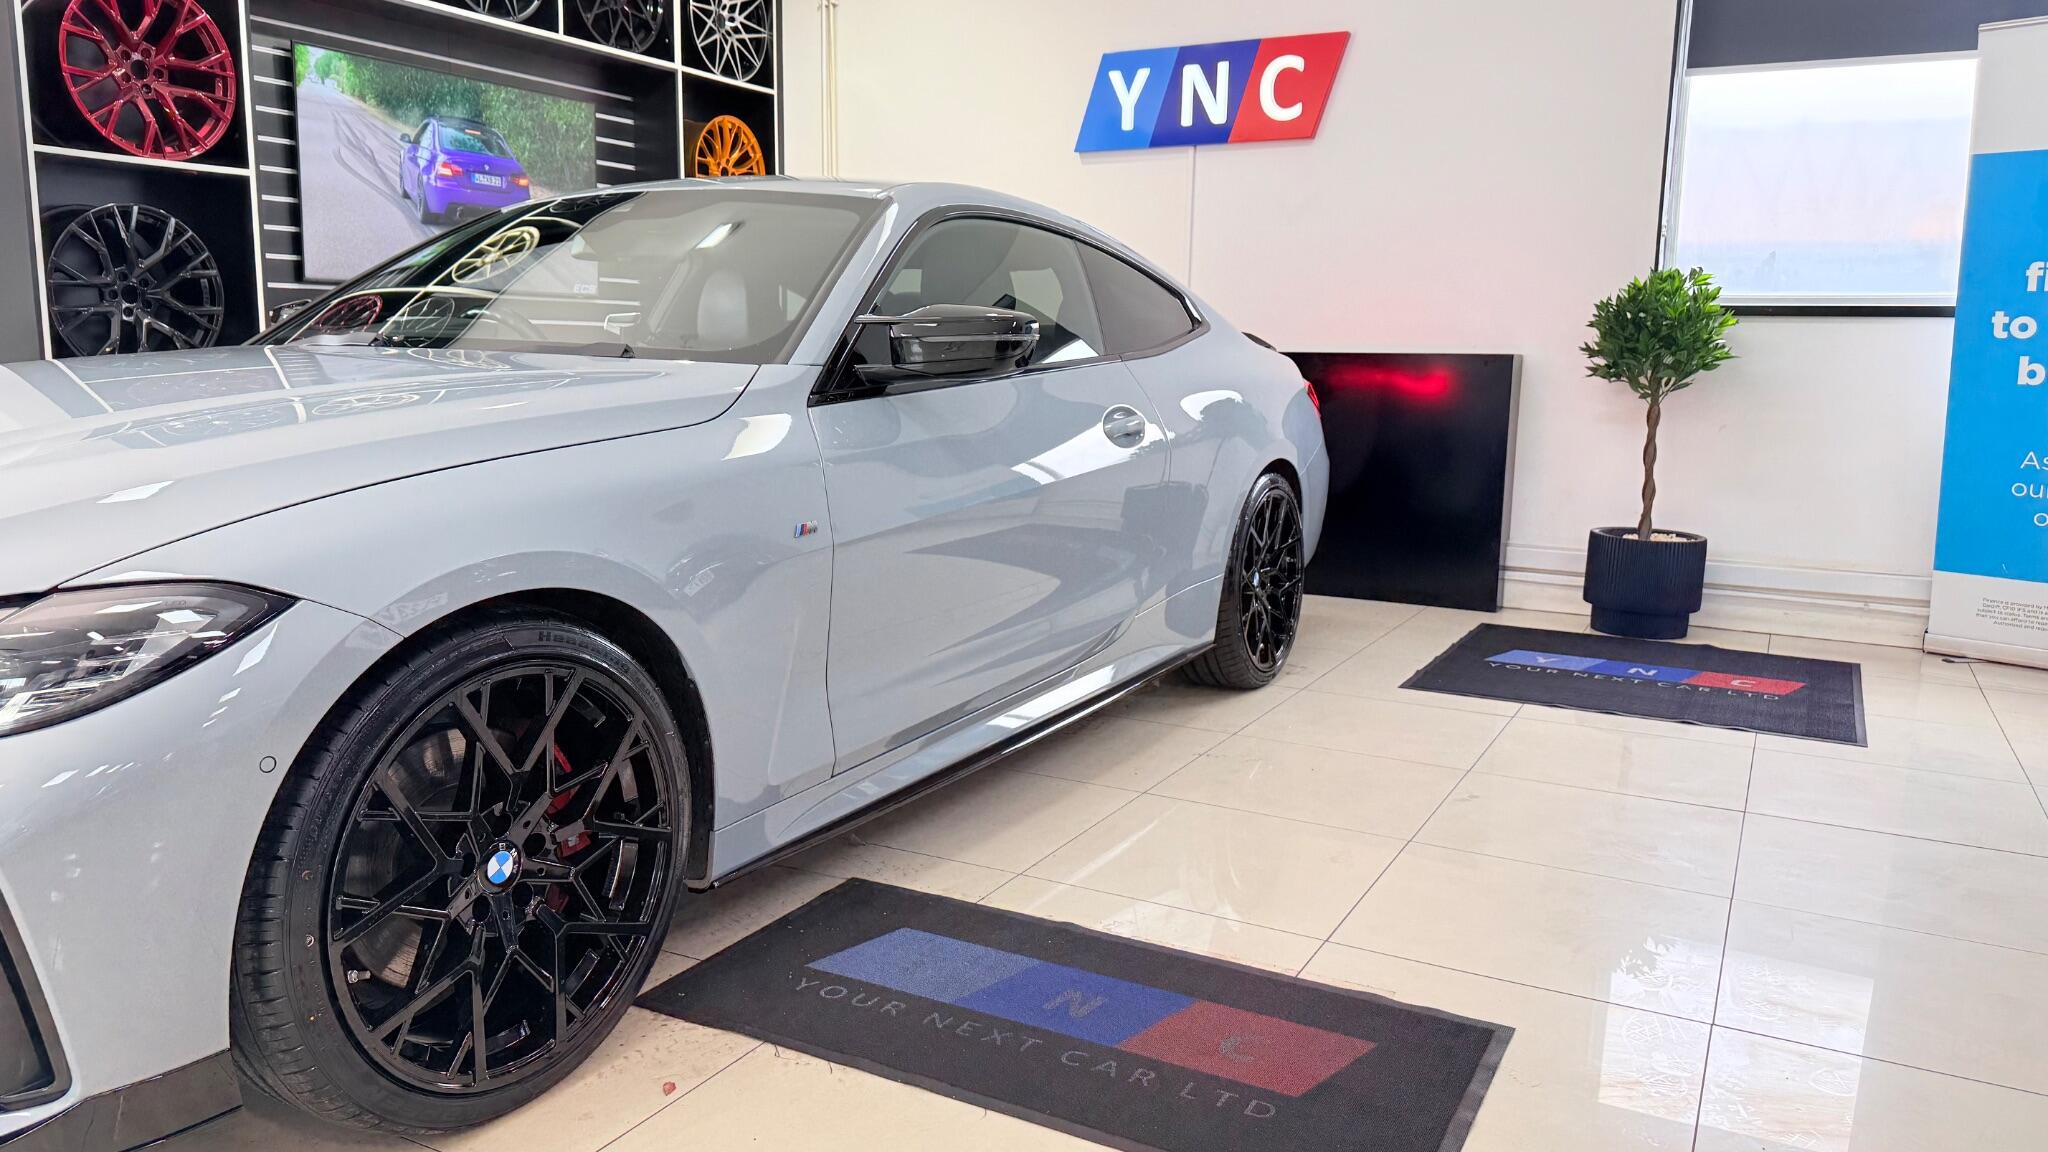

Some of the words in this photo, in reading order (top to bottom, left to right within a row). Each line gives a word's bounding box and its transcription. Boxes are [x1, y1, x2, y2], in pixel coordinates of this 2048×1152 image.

[1108, 54, 1305, 131] YNC
[1992, 311, 2037, 339] to
[2011, 483, 2048, 498] ou
[1489, 662, 1559, 673] YOUR
[1573, 672, 1643, 684] NEXT
[1657, 681, 1711, 692] CAR
[1728, 690, 1779, 700] LTD
[1535, 656, 1756, 688] YNC
[796, 977, 906, 1017] YOUR
[923, 1012, 1043, 1051] NEXT
[1061, 1050, 1155, 1087] CAR
[1178, 1082, 1276, 1118] LTD
